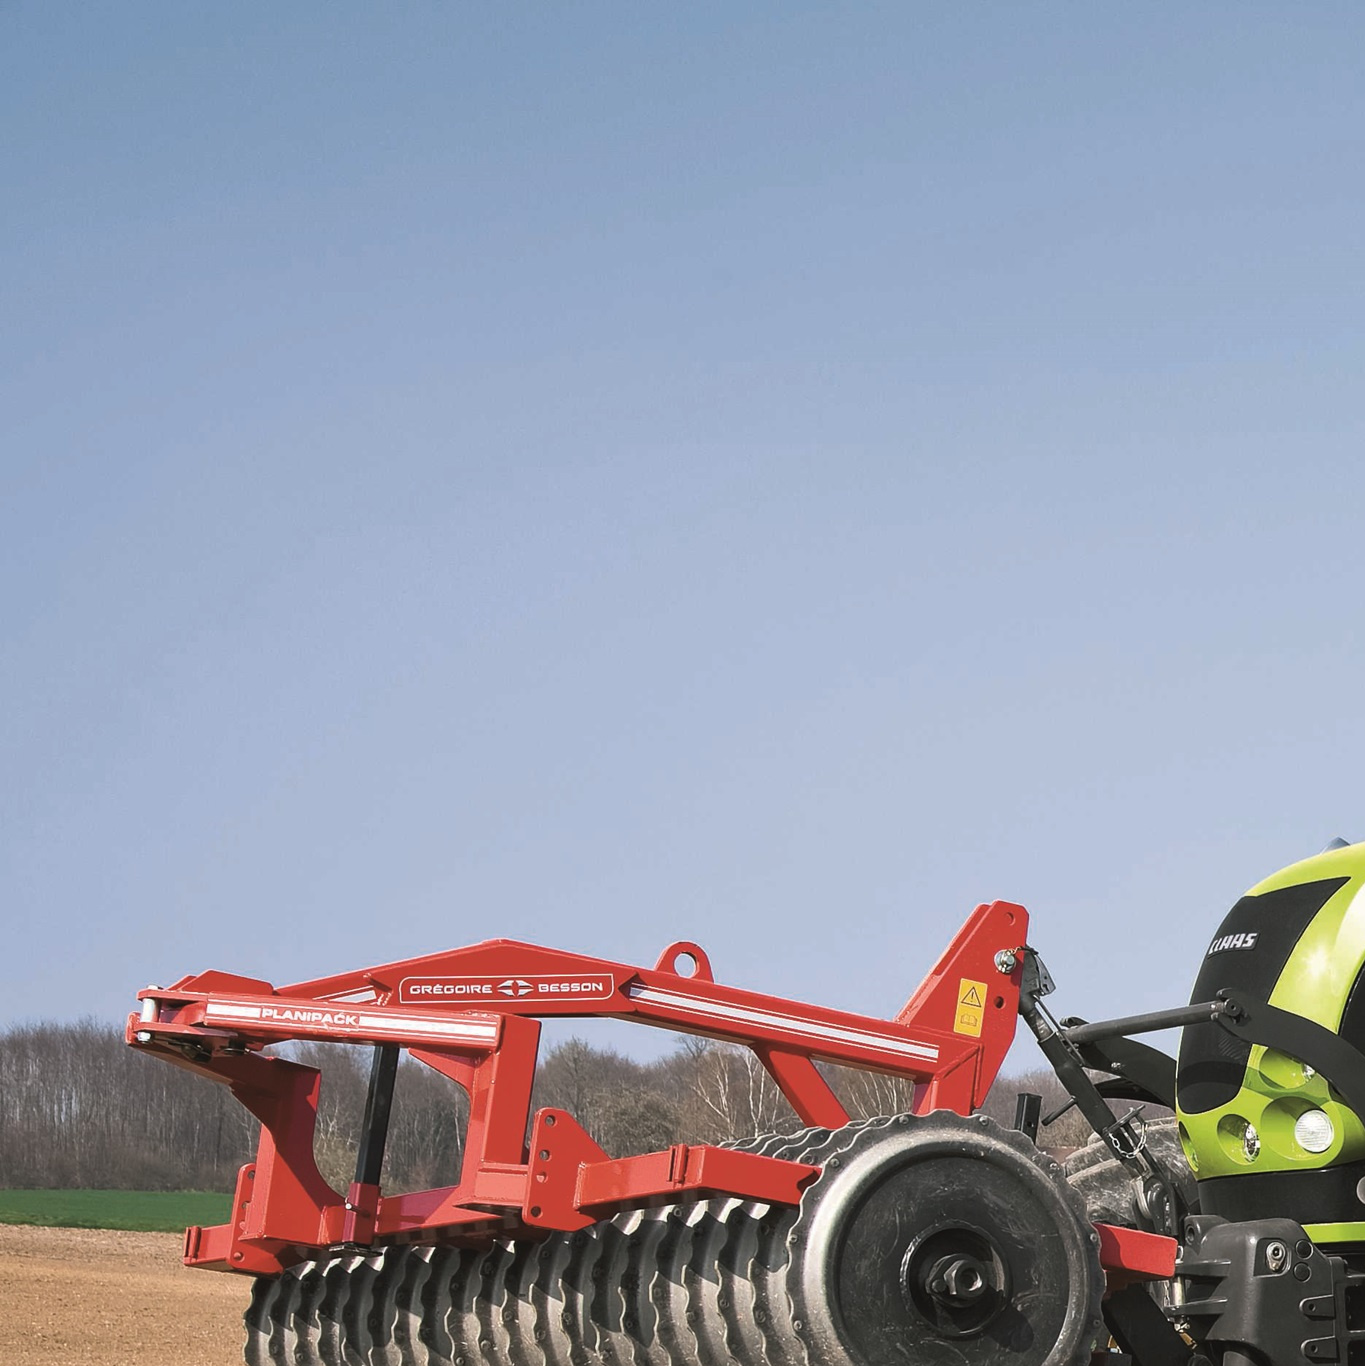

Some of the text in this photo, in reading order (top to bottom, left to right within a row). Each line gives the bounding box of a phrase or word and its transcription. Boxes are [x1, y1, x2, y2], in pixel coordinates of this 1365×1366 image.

[1207, 932, 1258, 956] CLAAS
[409, 981, 603, 995] GRÉGOIRE BESSON
[260, 1007, 360, 1027] PLANIPACK
